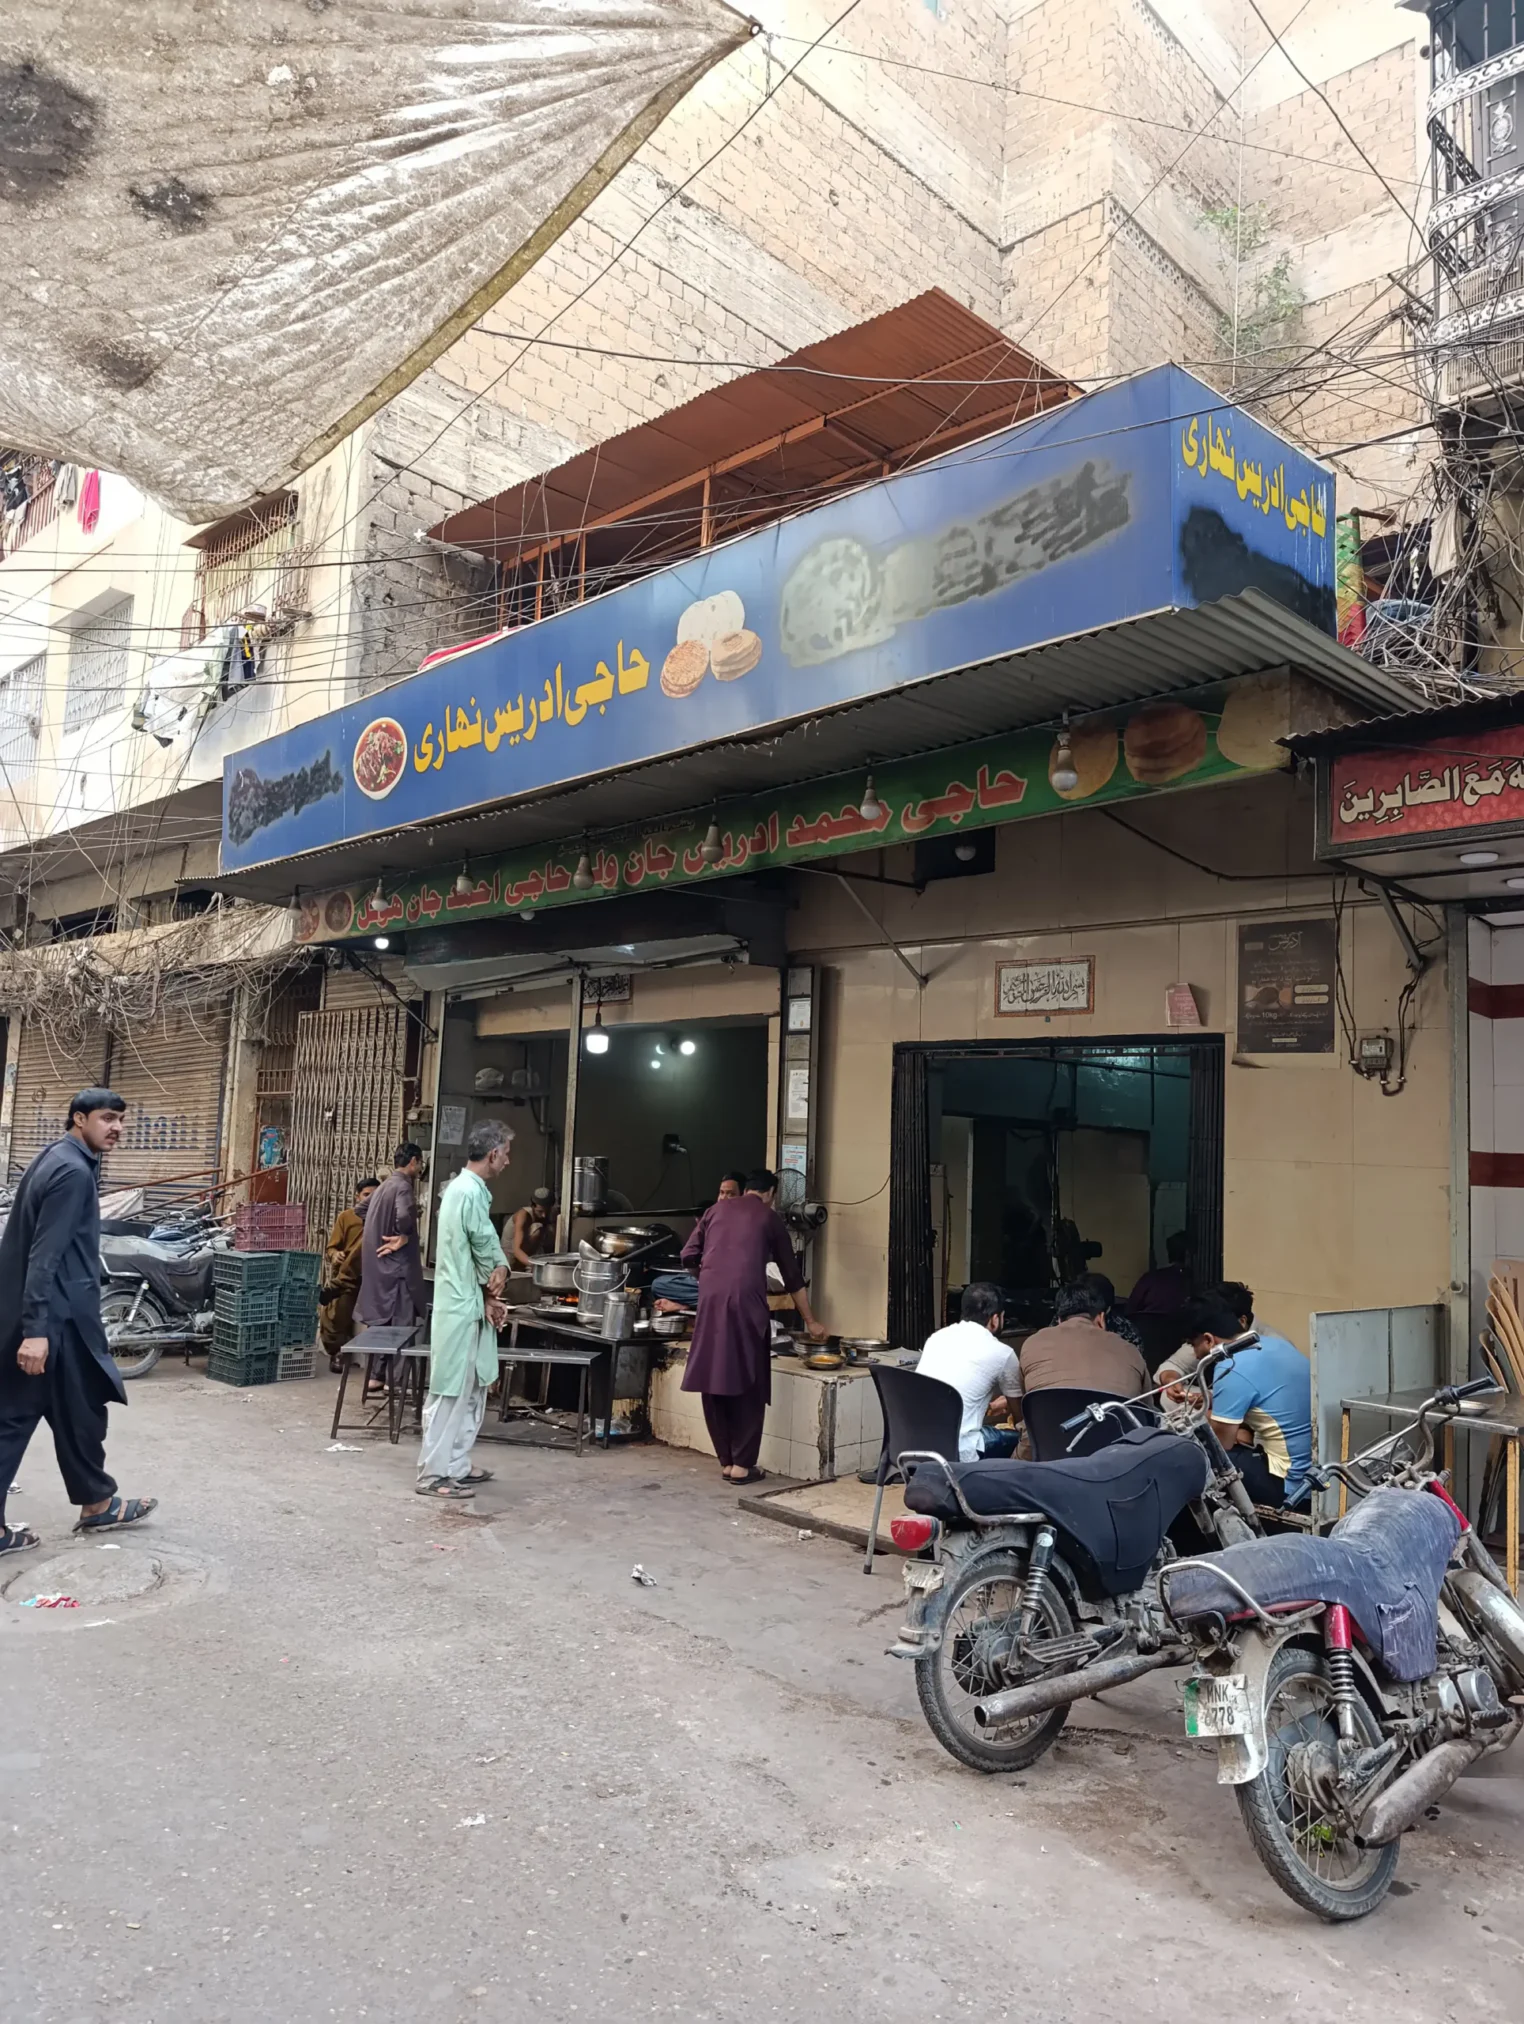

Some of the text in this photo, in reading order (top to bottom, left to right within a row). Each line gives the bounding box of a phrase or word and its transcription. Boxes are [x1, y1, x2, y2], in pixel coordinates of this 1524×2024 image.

[1236, 457, 1286, 516] ادریس
[484, 661, 563, 753] ادریس
[564, 638, 650, 727] حاجی
[786, 799, 893, 848] محمد
[901, 764, 1028, 834] حاجی
[504, 858, 572, 907] حاجی
[623, 837, 677, 886] جان
[405, 883, 442, 924] جان
[1206, 1683, 1230, 1704] MNK
